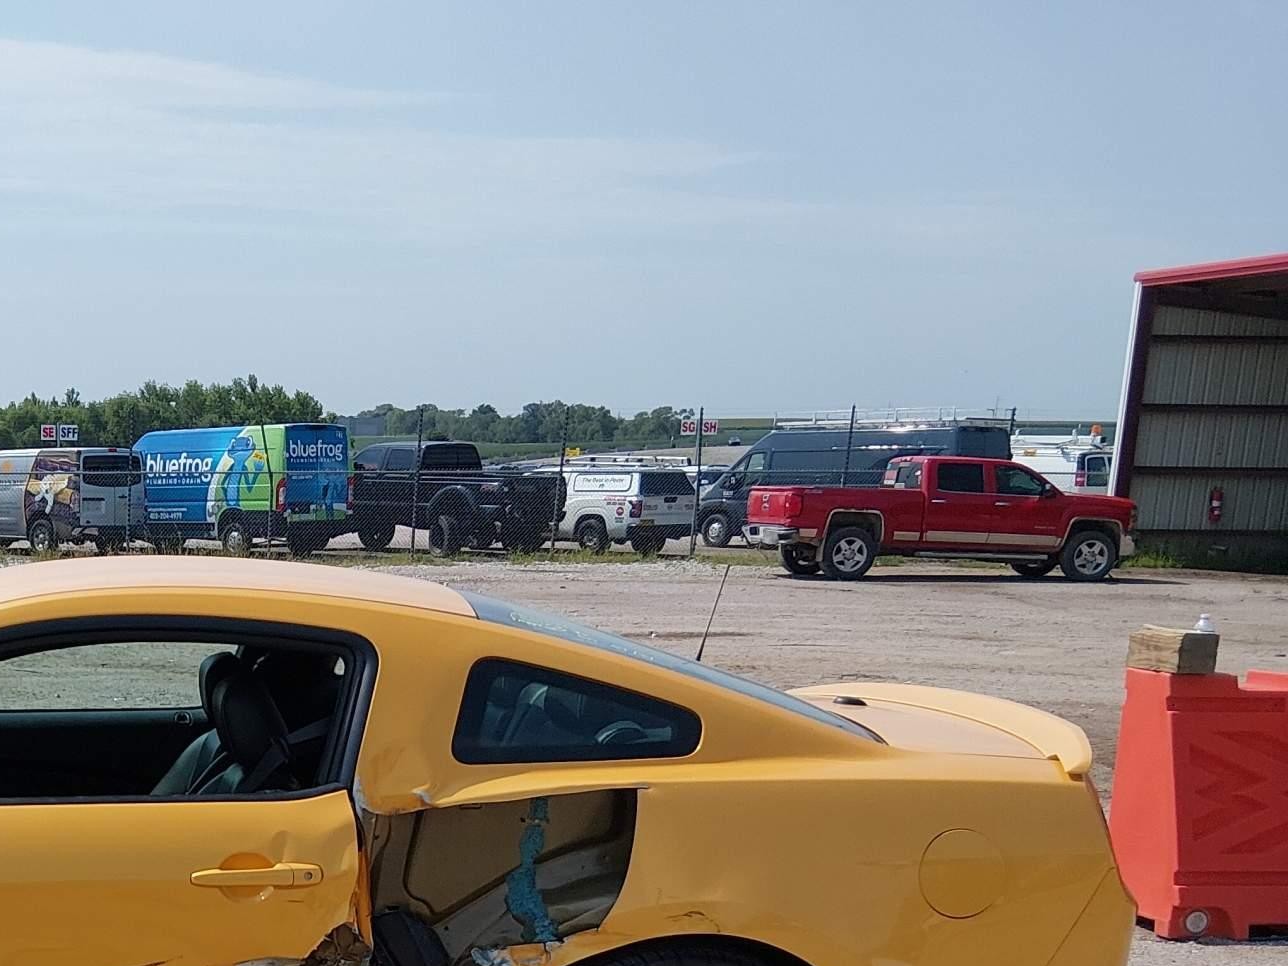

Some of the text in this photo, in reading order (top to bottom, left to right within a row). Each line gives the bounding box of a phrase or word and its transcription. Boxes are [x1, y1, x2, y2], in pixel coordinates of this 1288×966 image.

[42, 426, 55, 438] SE
[61, 426, 78, 438] SFF
[682, 421, 696, 433] SG
[703, 421, 717, 433] SH
[289, 439, 343, 462] bluefrog
[146, 452, 213, 483] bluefrog
